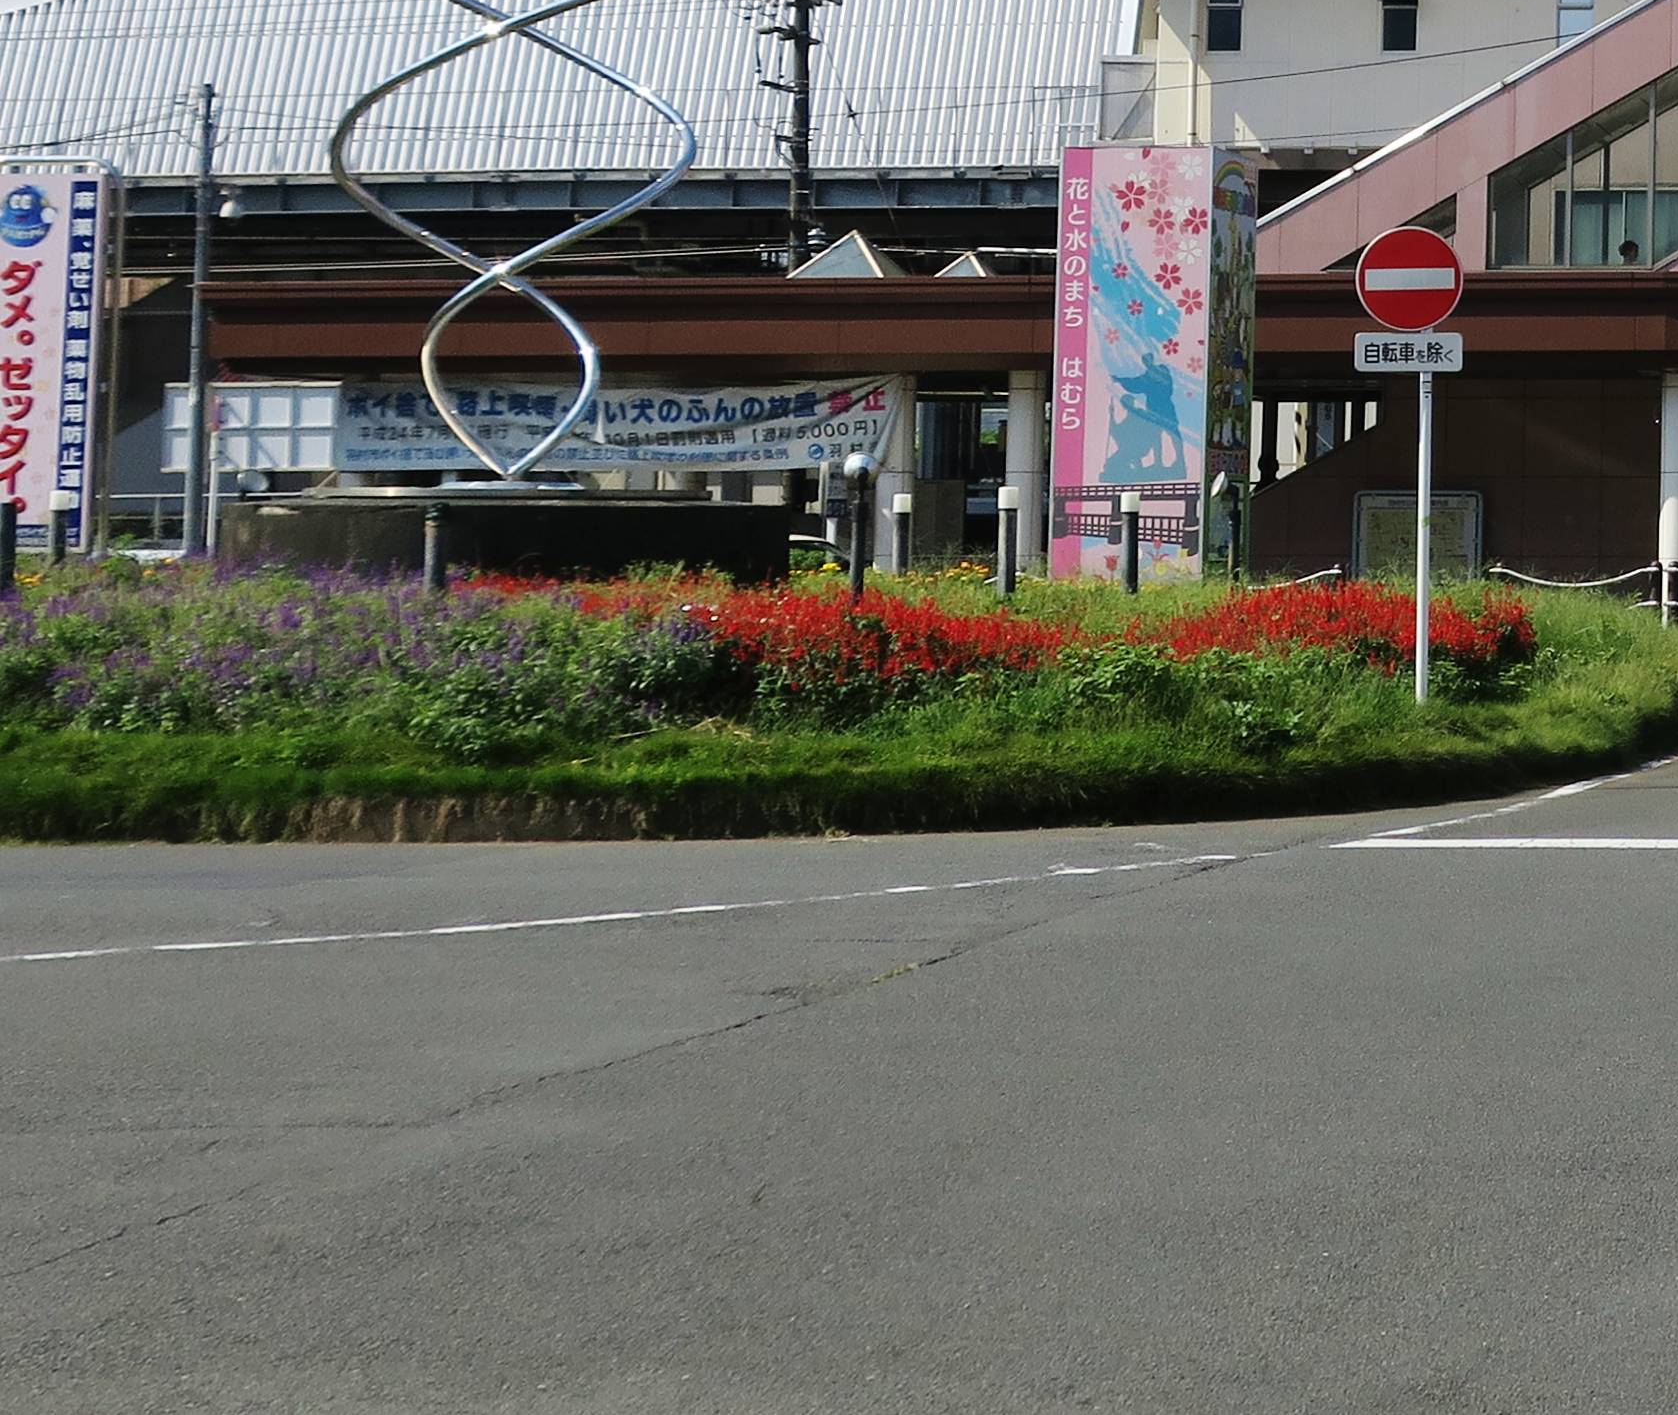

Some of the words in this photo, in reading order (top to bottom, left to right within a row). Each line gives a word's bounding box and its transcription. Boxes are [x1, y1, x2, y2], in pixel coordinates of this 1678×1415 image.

[67, 191, 96, 329] 麻薬、覚せい剤
[1062, 177, 1090, 327] 花と水のまち
[1364, 342, 1454, 364] 自転車を除く
[826, 387, 887, 416] 禁止
[1060, 355, 1084, 431] はむら
